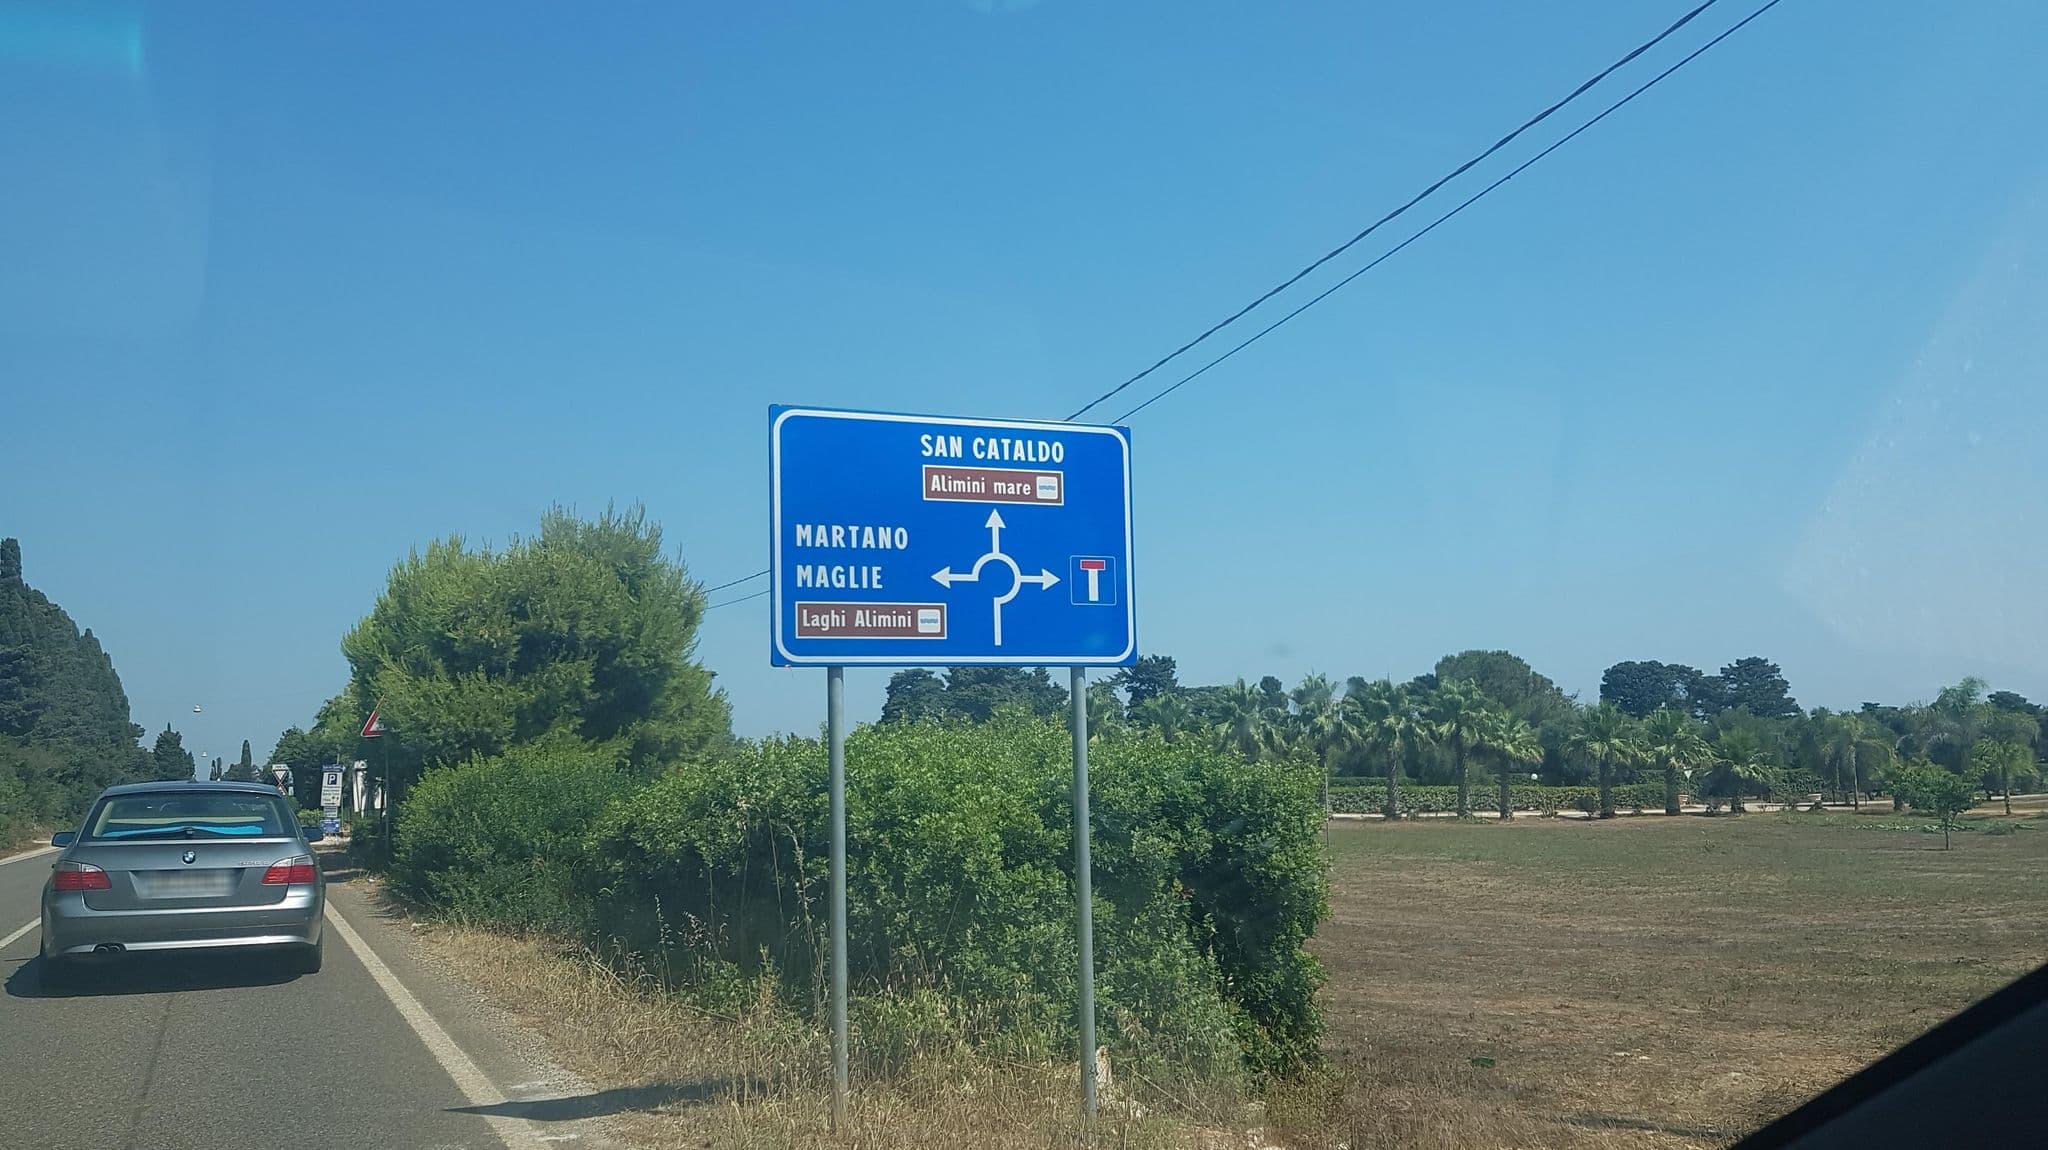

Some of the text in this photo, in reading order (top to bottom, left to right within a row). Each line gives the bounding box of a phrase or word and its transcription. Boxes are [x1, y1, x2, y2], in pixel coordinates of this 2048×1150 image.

[920, 434, 1064, 463] SAN CATALDO
[931, 475, 1031, 496] Alimini mare
[796, 524, 908, 550] MARTANO
[796, 565, 883, 589] MAGLIE
[802, 609, 912, 631] Laghi Alimini
[328, 774, 336, 785] P
